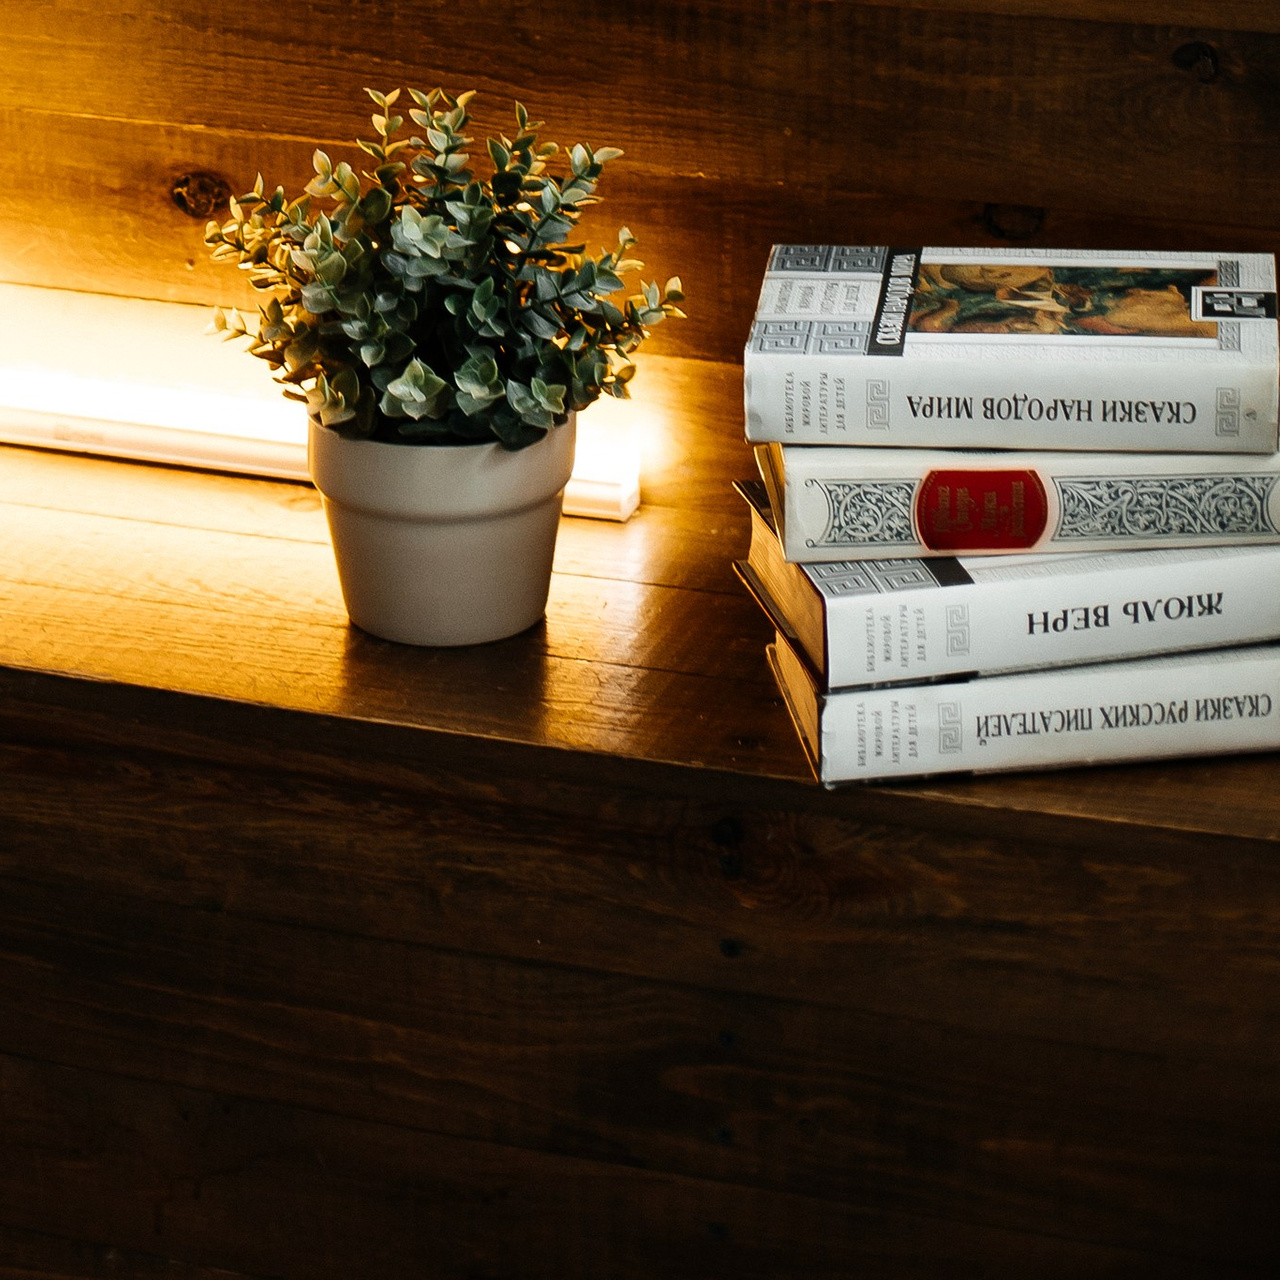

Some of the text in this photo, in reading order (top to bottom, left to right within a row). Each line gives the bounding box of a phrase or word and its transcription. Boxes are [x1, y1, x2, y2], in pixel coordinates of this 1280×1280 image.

[906, 394, 1197, 423] СКАЗКИ НАРОДОВ МИРА
[1027, 592, 1224, 635] ЖЮЛЬ ВЕРН
[976, 693, 1272, 747] СКАЗКИ РУССКИХ ПИСАТЕЛЕЙ
